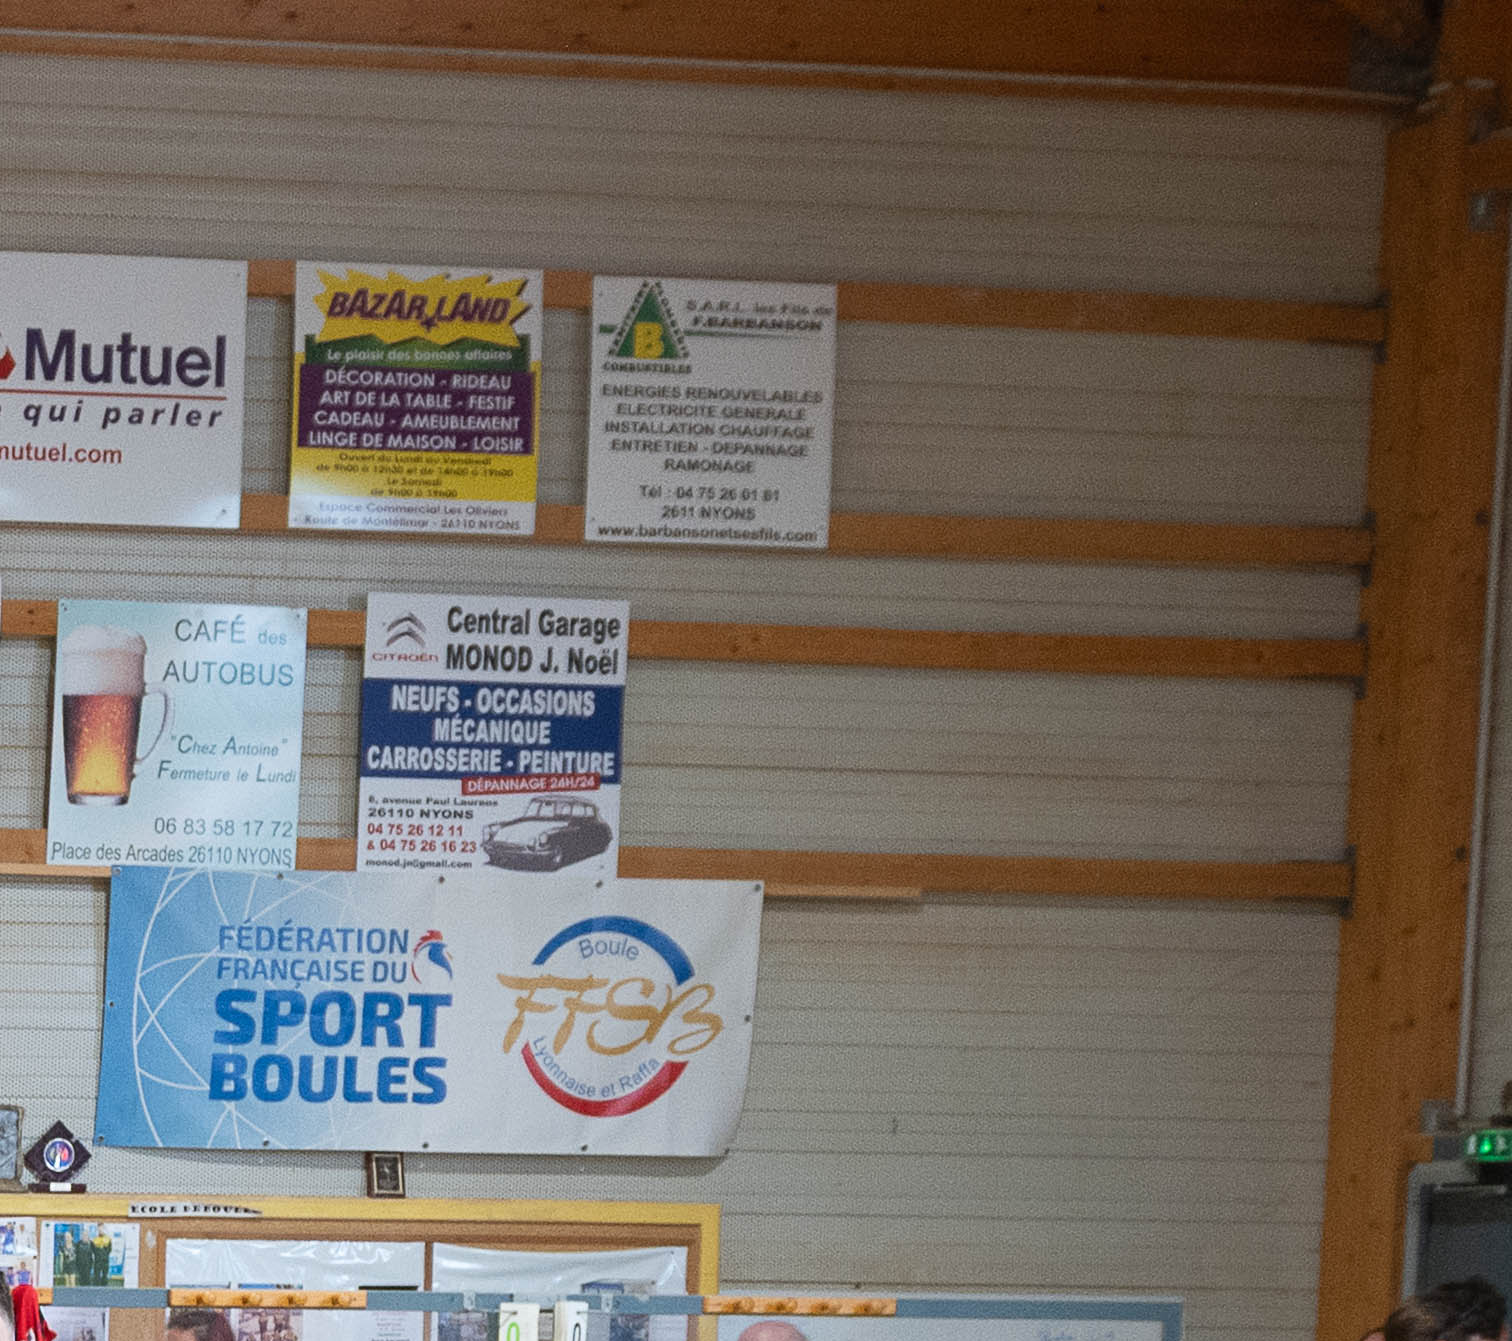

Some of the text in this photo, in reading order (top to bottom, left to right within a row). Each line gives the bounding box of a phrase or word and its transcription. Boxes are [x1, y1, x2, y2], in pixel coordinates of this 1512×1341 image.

[24, 327, 227, 388] Mutuel
[325, 367, 512, 390] DÉCORATION RIDEAU
[314, 411, 520, 430] CADEAU AMEUBLEMENT
[617, 403, 805, 420] ELECTRICITE GENERALE
[664, 458, 756, 473] RAMONAGE
[700, 507, 756, 520] NYONS
[175, 614, 287, 645] CAFÉ des
[447, 606, 620, 644] Central Garage
[162, 660, 294, 687] AUTOBUS
[391, 685, 595, 717] NEUFS OCCASIONS
[434, 716, 551, 744] MÉCANIQUE
[367, 746, 614, 776] CARROSSERIE PEINTURE
[155, 817, 292, 837] 06 83 58 17 72
[368, 809, 474, 819] 26110 NYONS
[218, 921, 408, 954] FÉDÉRATION
[579, 938, 639, 961] Boule
[217, 958, 407, 986] FRANÇAISE DU
[214, 989, 453, 1048] SPORT
[208, 1054, 448, 1104] BOULES
[131, 1204, 177, 1214] ECOLE
